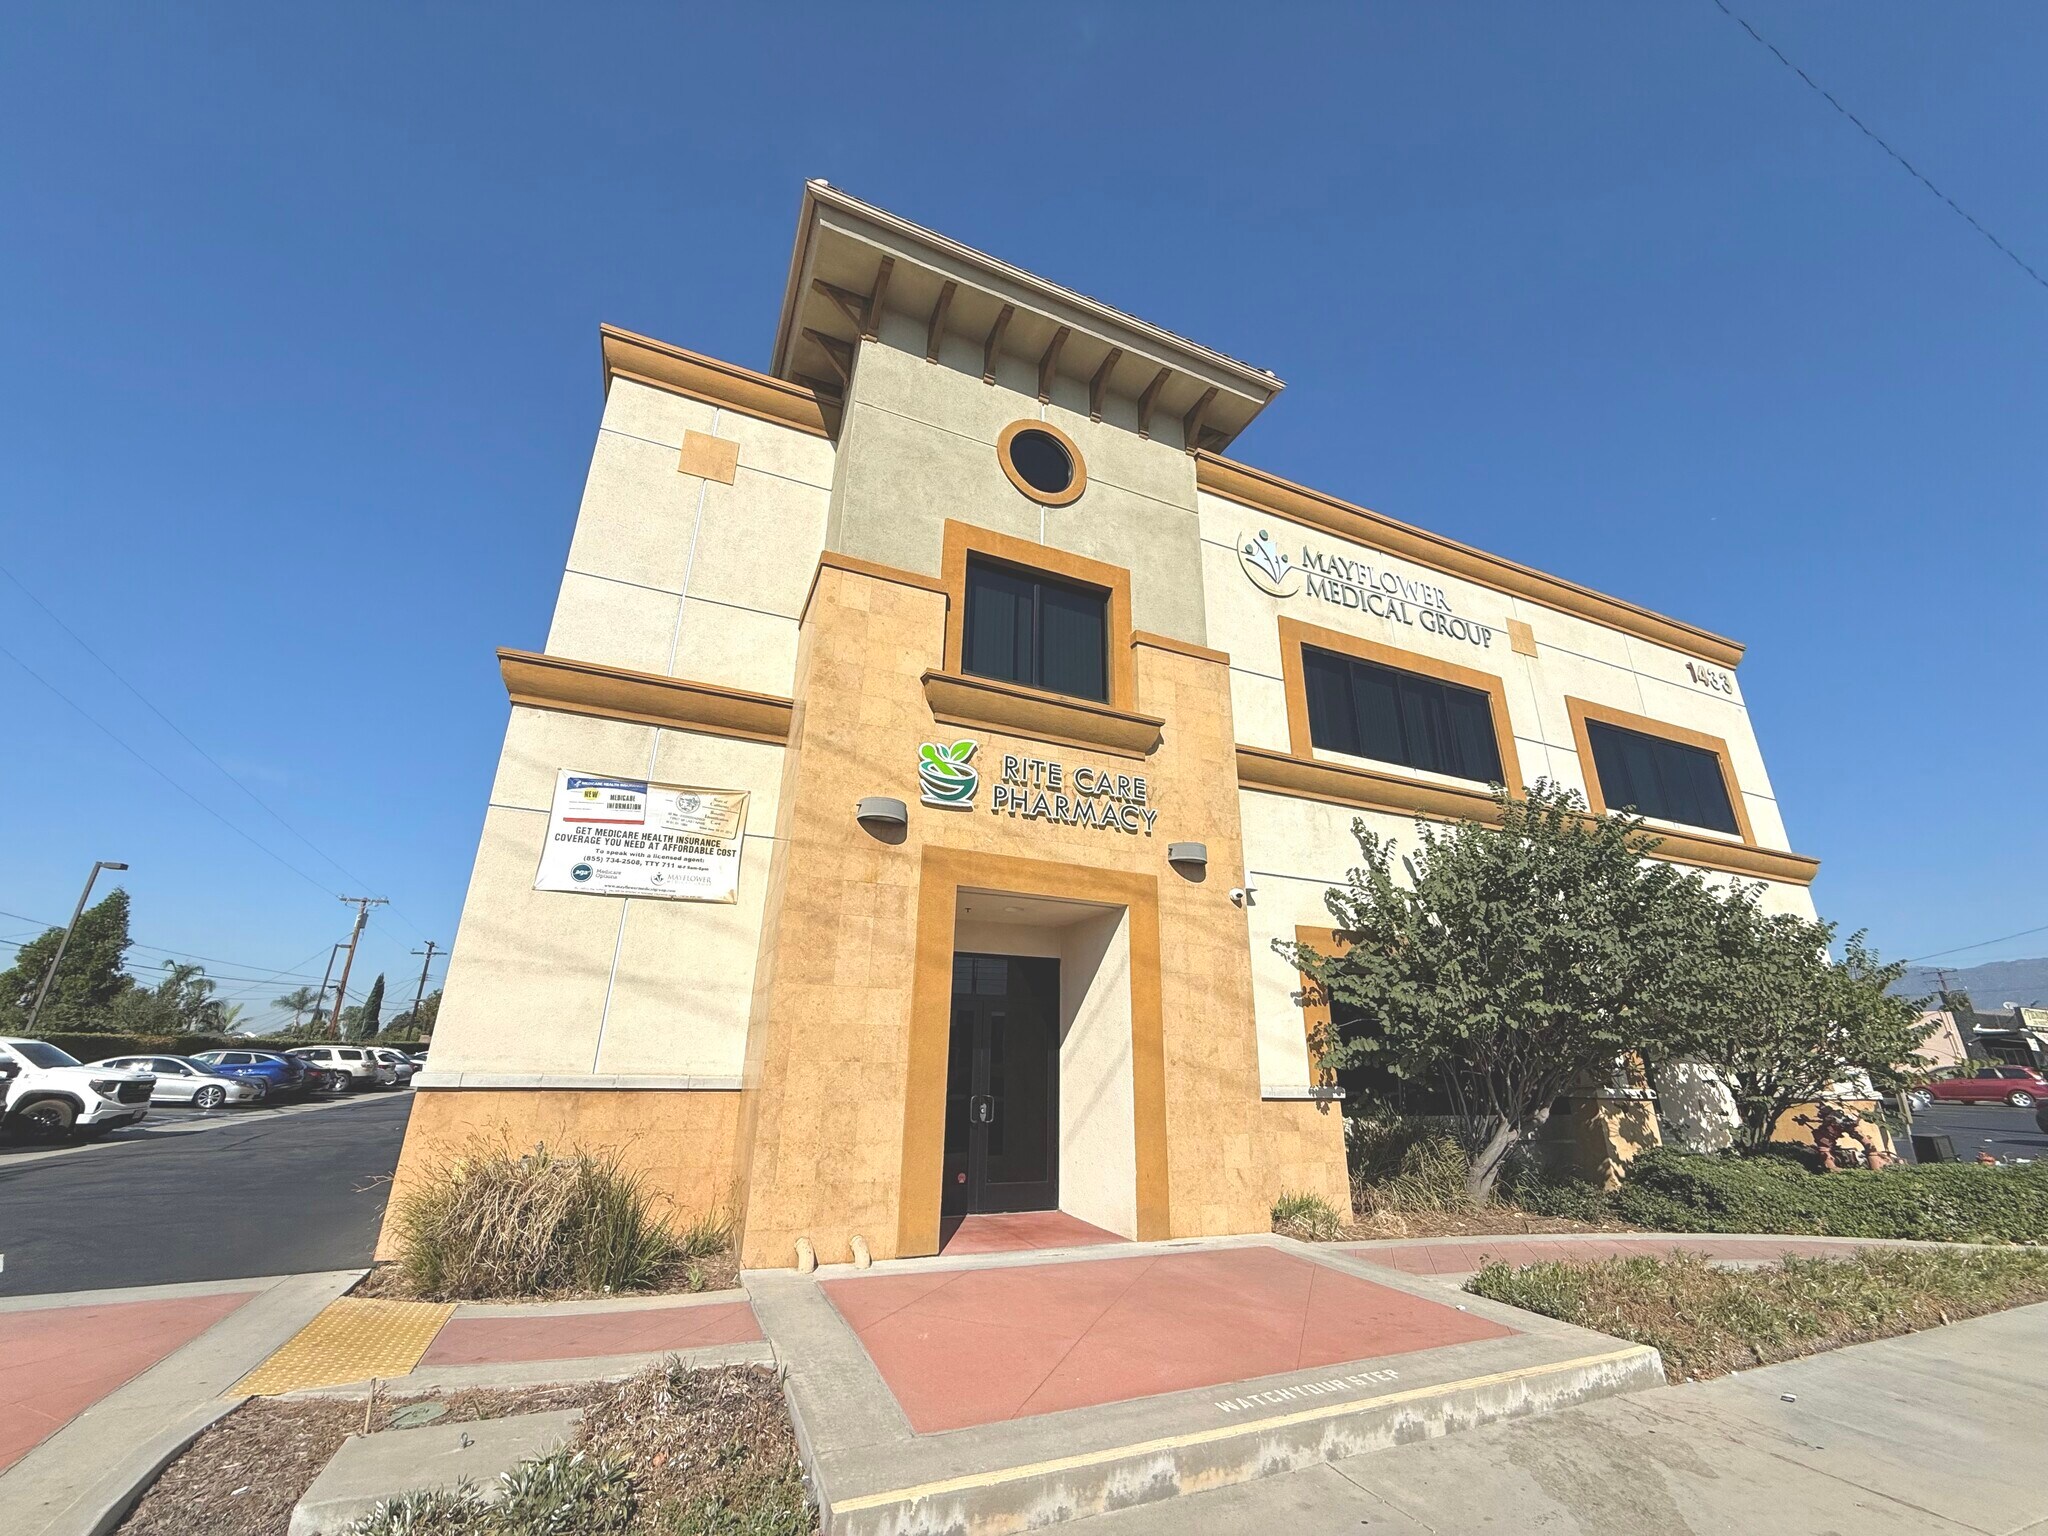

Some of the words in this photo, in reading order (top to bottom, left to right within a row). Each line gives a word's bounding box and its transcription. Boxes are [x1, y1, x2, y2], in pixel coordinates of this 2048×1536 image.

[1302, 545, 1452, 612] MAYFLOWER
[1306, 573, 1413, 626] MEDICAL
[1419, 610, 1492, 648] GROUP
[1685, 661, 1733, 695] 1433
[1003, 754, 1063, 790] RITE
[1074, 767, 1147, 803] CARE
[583, 790, 599, 798] NEW
[606, 802, 642, 810] INFORMATION
[609, 794, 636, 802] MEDICARE
[992, 783, 1158, 835] PHARMACY
[554, 832, 602, 845] COVERAGE
[604, 838, 621, 847] YOU
[624, 840, 646, 849] NEED
[648, 842, 660, 850] AT
[662, 843, 714, 856] AFFORDABLE
[716, 848, 737, 858] COST
[575, 826, 592, 835] GET
[595, 828, 639, 840] MEDICARE
[641, 833, 674, 843] HEALTH
[675, 837, 721, 848] INSURANCE
[583, 855, 604, 863] (855)
[605, 857, 643, 867] 734-2508,
[652, 853, 682, 861] licensed
[666, 873, 711, 883] MAYFLOWER
[1214, 1388, 1297, 1413] WATCH
[1289, 1378, 1351, 1397] YOUR
[1345, 1368, 1400, 1387] STEP
